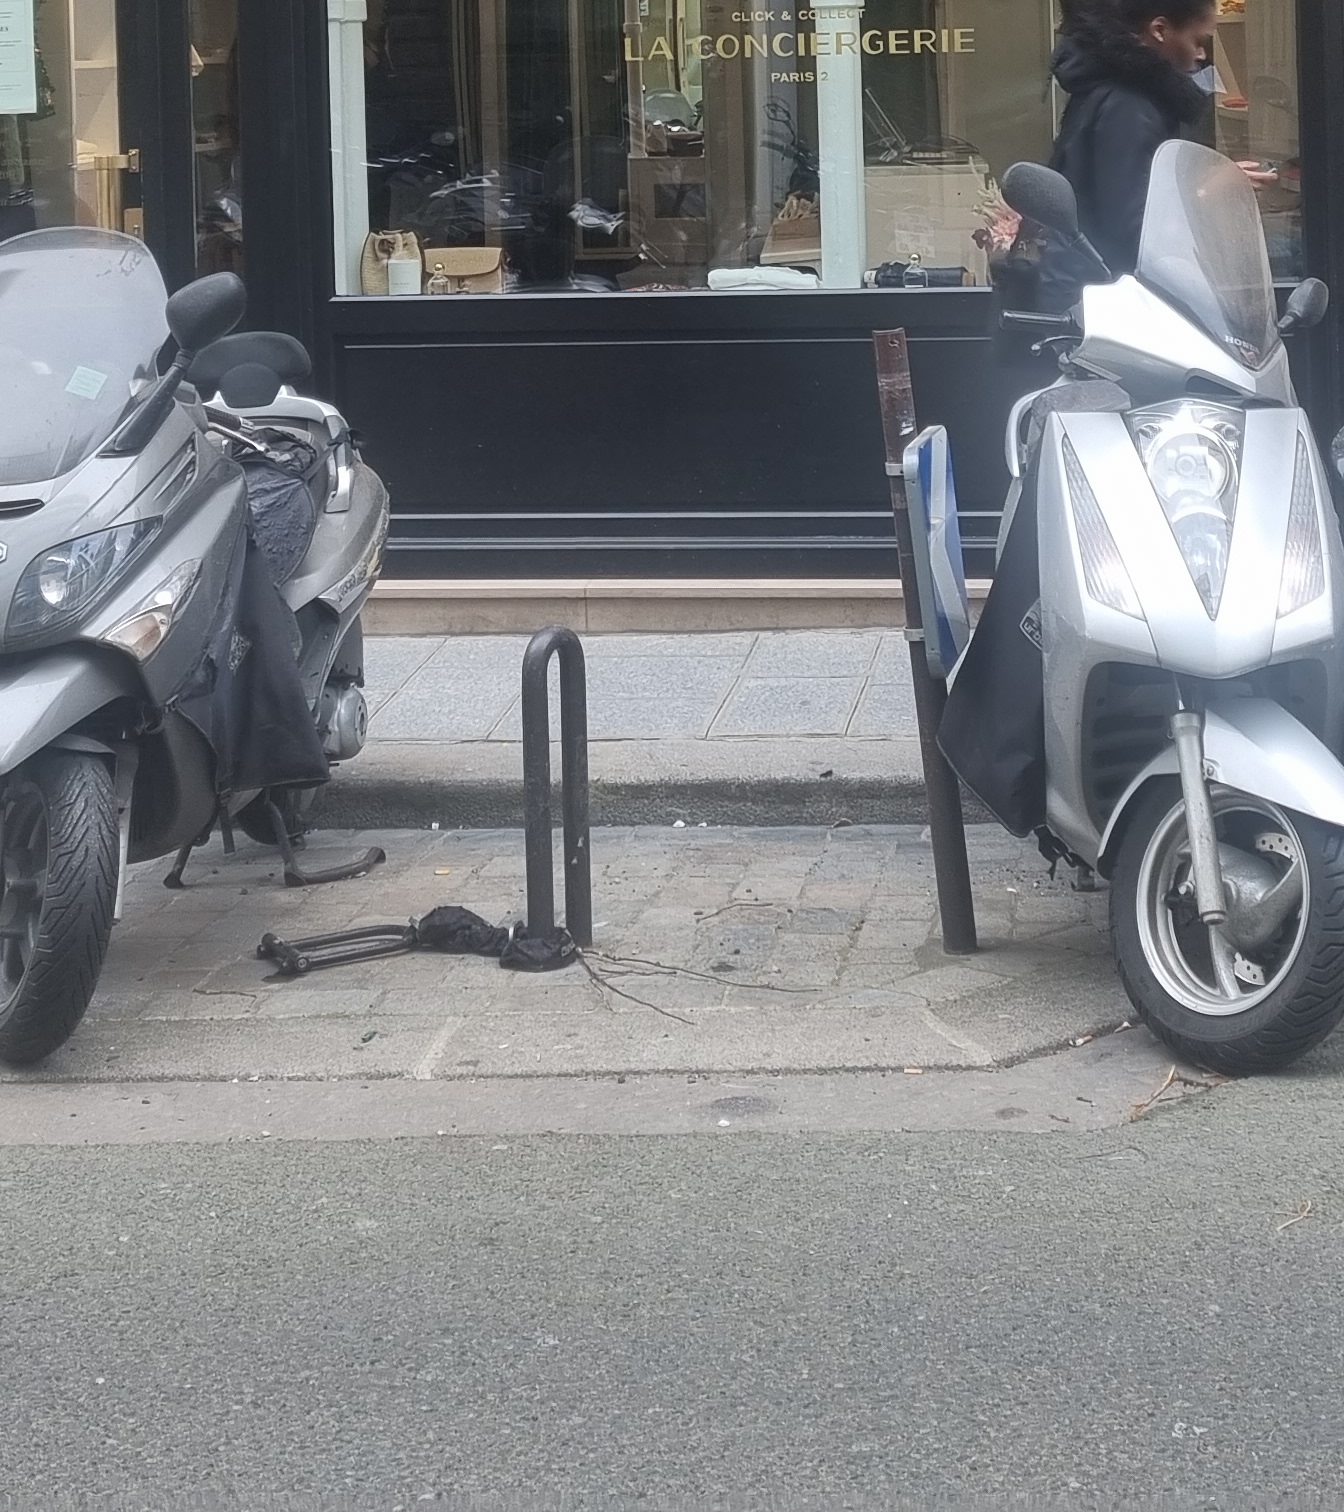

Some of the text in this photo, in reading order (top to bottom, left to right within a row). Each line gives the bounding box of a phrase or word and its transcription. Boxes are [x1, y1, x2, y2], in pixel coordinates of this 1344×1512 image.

[732, 8, 866, 22] CLICK & COLLECT
[624, 28, 976, 61] LA CONCIERGERIE
[771, 71, 829, 83] PARIS 2
[1224, 334, 1260, 354] HONDA
